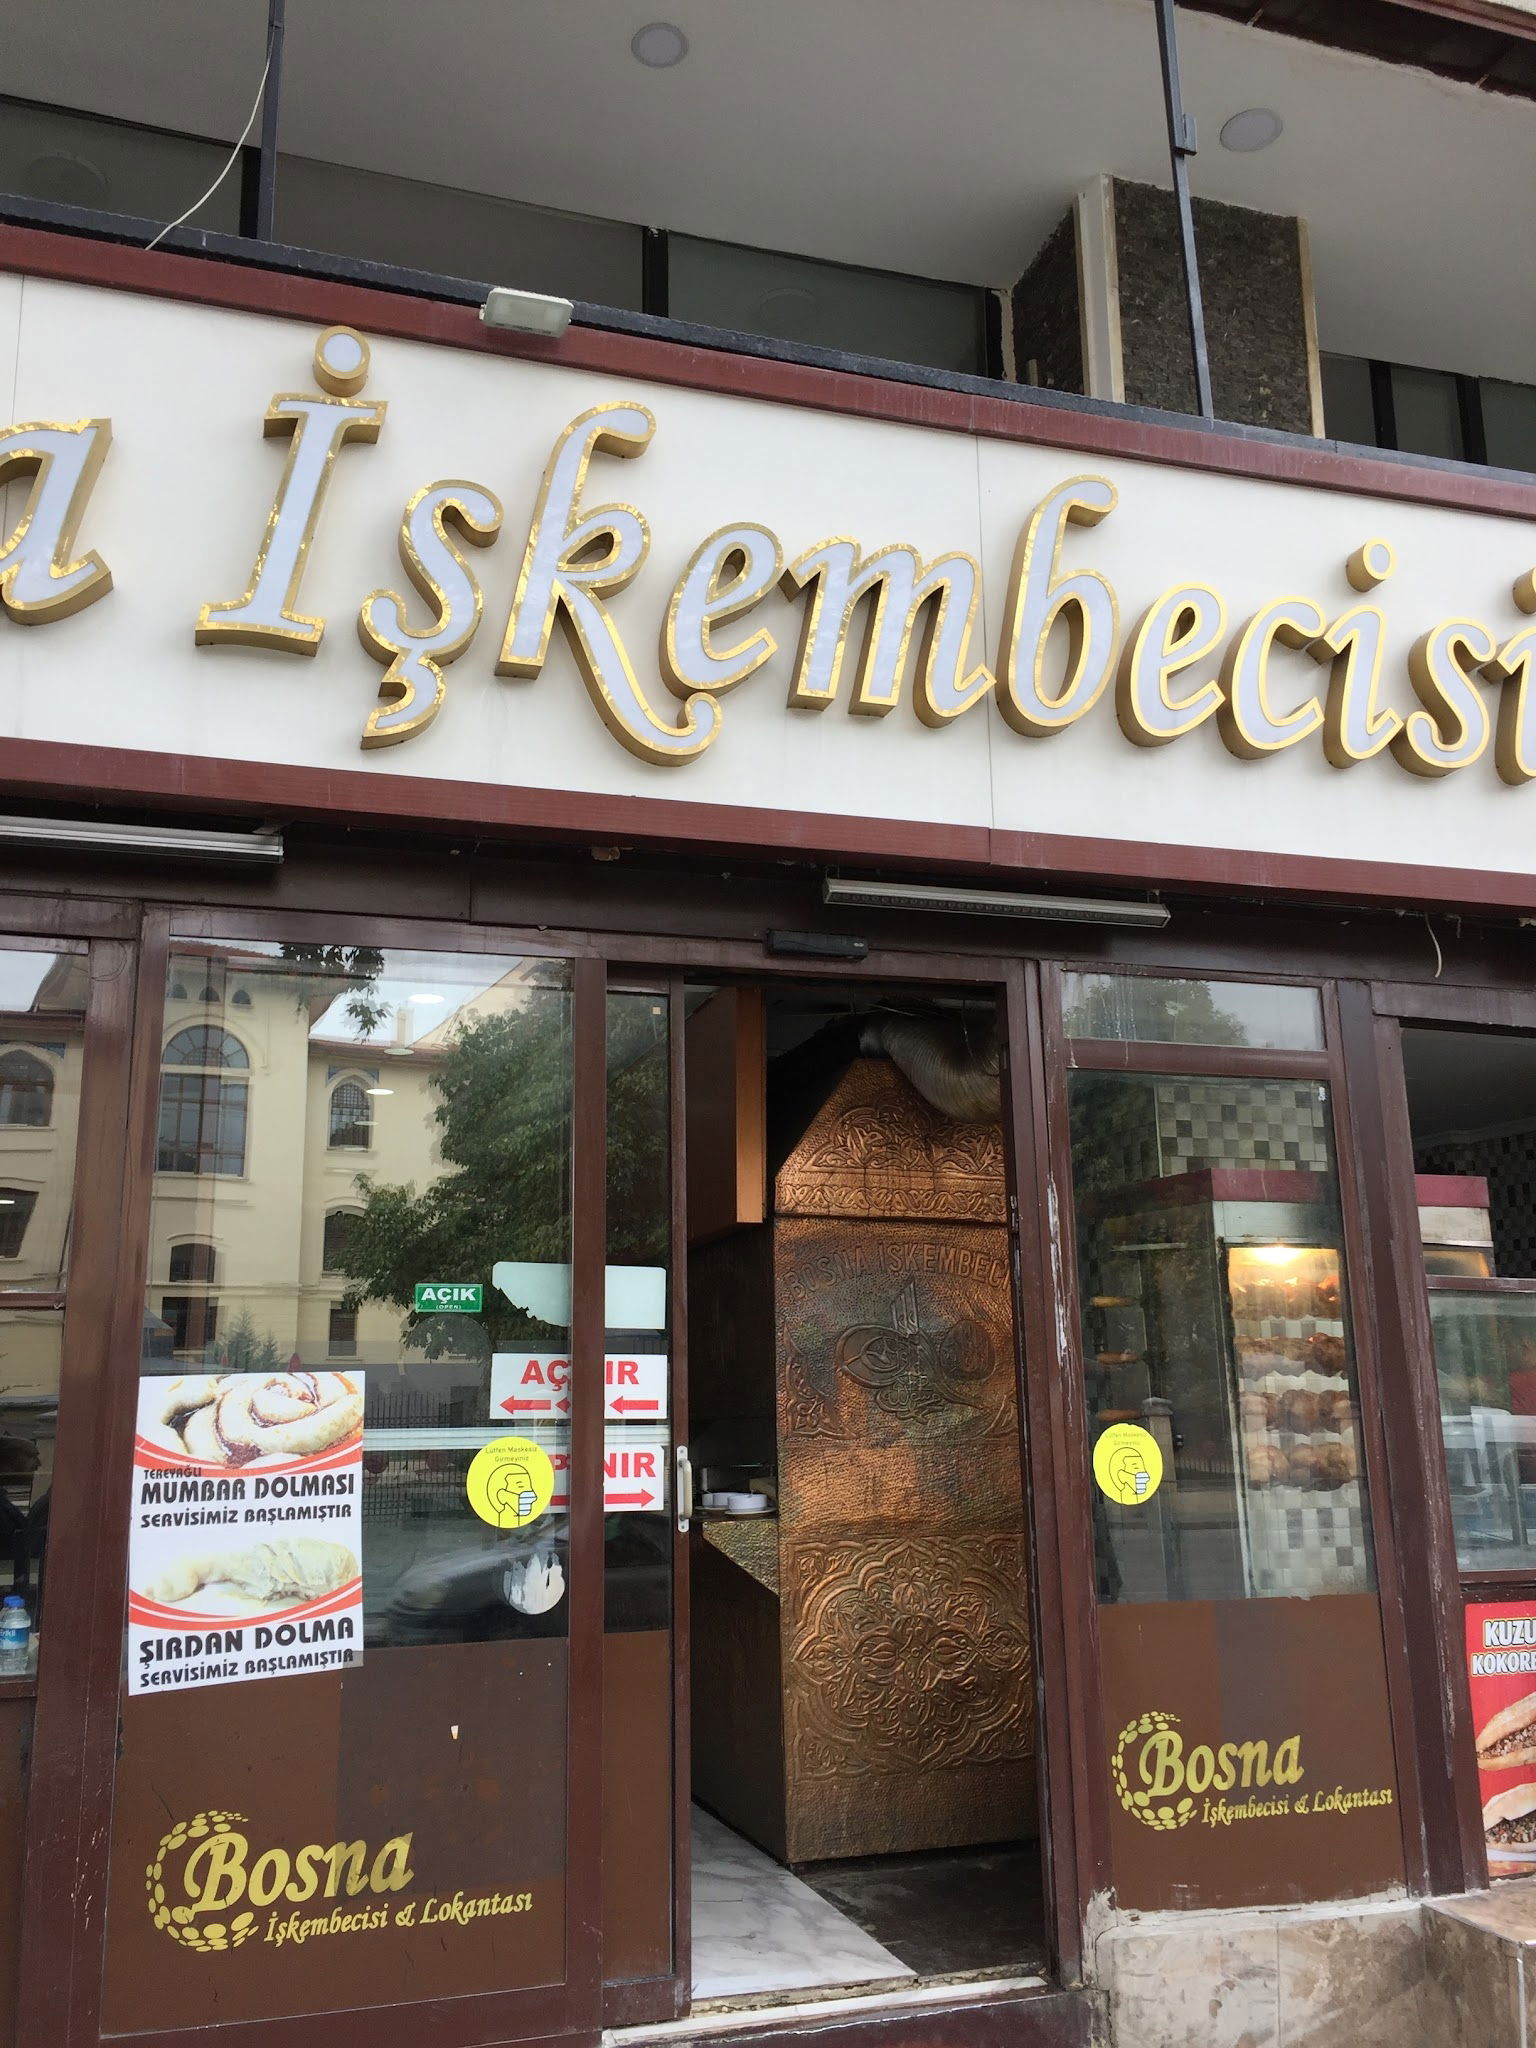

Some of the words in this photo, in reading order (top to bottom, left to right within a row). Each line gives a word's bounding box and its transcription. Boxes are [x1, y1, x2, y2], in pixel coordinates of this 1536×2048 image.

[195, 325, 1536, 787] İşkembecisi
[784, 1246, 868, 1300] BOSNA
[421, 1287, 476, 1304] AÇIK
[141, 1479, 246, 1505] MUMBAR
[255, 1473, 355, 1499] DOLMASI
[144, 1464, 202, 1480] TEREYAĞLI
[141, 1506, 238, 1528] SERVİSİMİZ
[245, 1504, 352, 1525] BAŞLAMIŞTIR
[139, 1630, 243, 1669] ŞIRDAN
[255, 1617, 354, 1649] DOLMA
[1483, 1617, 1536, 1649] KUZU
[140, 1659, 239, 1687] SERVİSİMİZ
[245, 1648, 354, 1675] BAŞLAMIŞTIR
[1139, 1730, 1304, 1798] Bosna
[1201, 1795, 1289, 1828] İşkembecisi
[1294, 1794, 1310, 1814] &
[1312, 1785, 1393, 1815] Lokantası
[183, 1831, 415, 1913] Bosna
[264, 1903, 388, 1948] İşkembecisi
[395, 1901, 415, 1928] &
[419, 1890, 534, 1926] Lokantası
